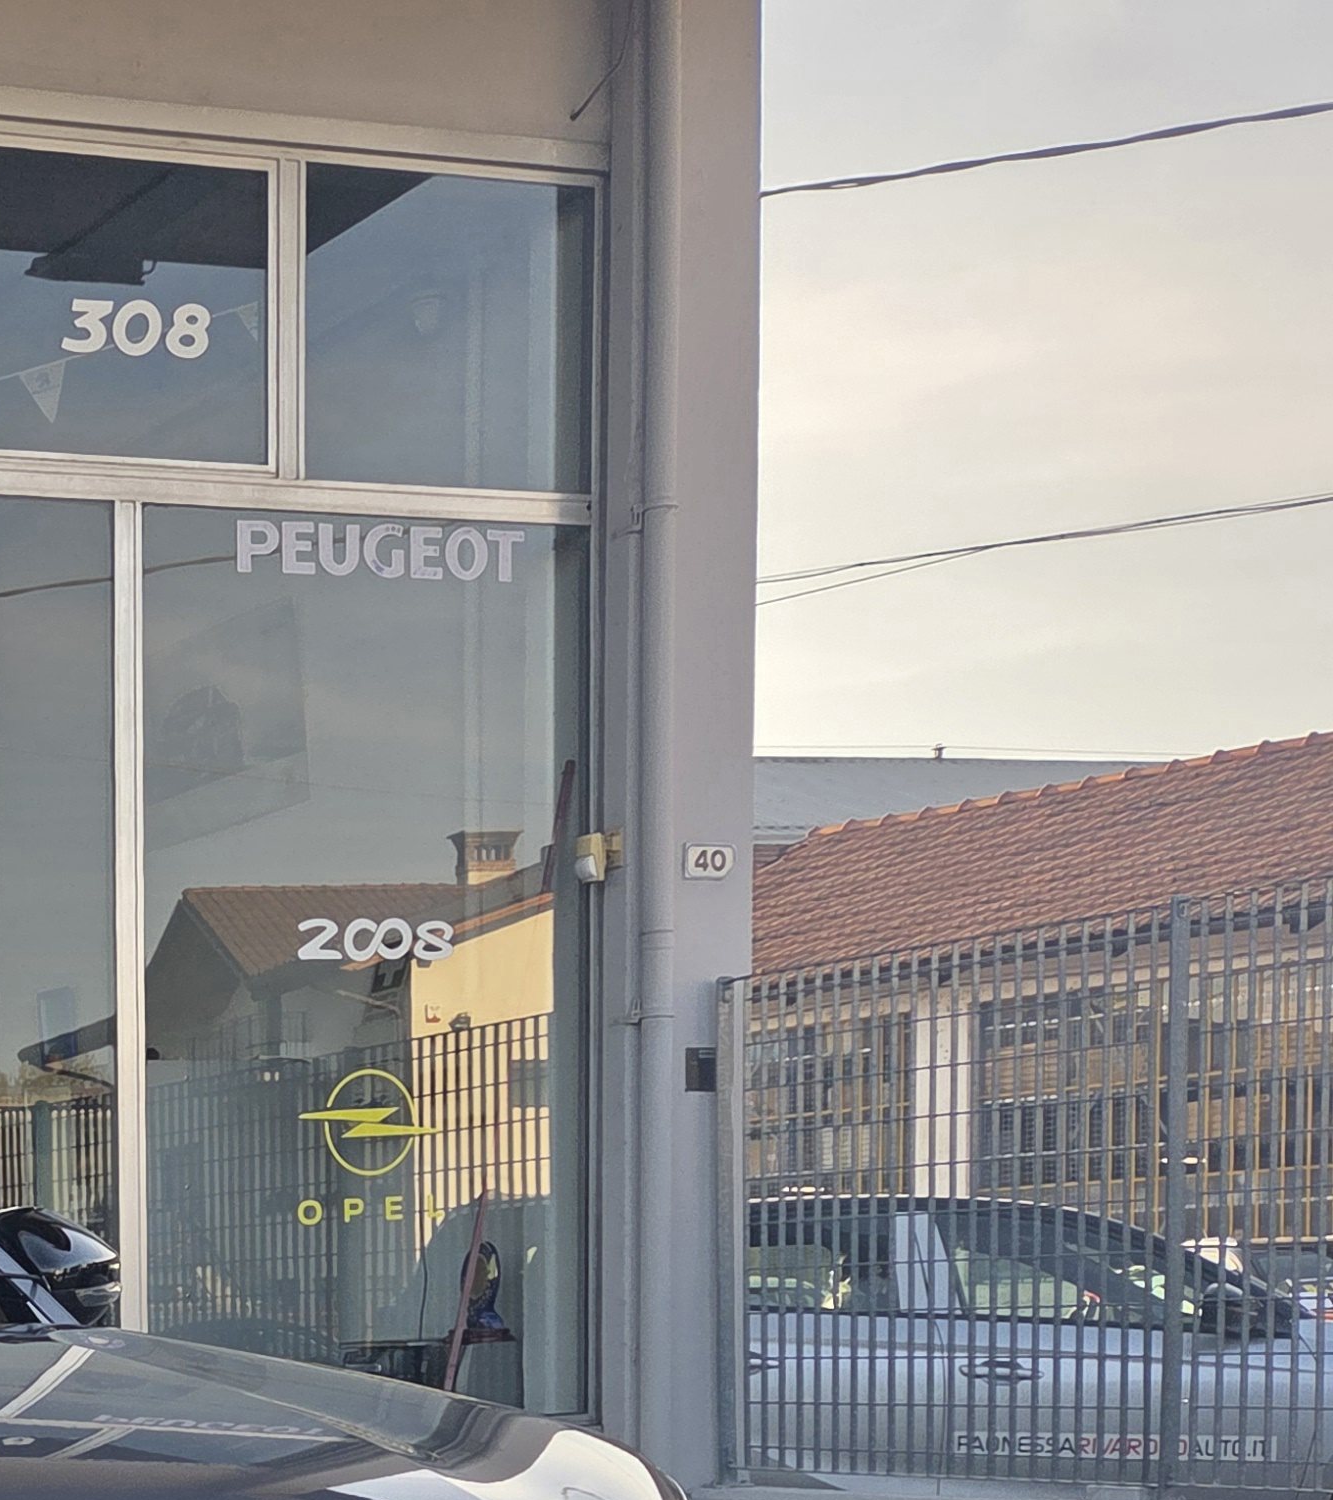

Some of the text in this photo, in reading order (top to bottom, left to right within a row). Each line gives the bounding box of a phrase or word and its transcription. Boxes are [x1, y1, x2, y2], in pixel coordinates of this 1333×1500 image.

[60, 297, 211, 360] 308
[235, 519, 525, 584] PEUGEOT
[693, 849, 727, 873] 40
[297, 917, 455, 962] 2008
[296, 1194, 446, 1226] OPEL
